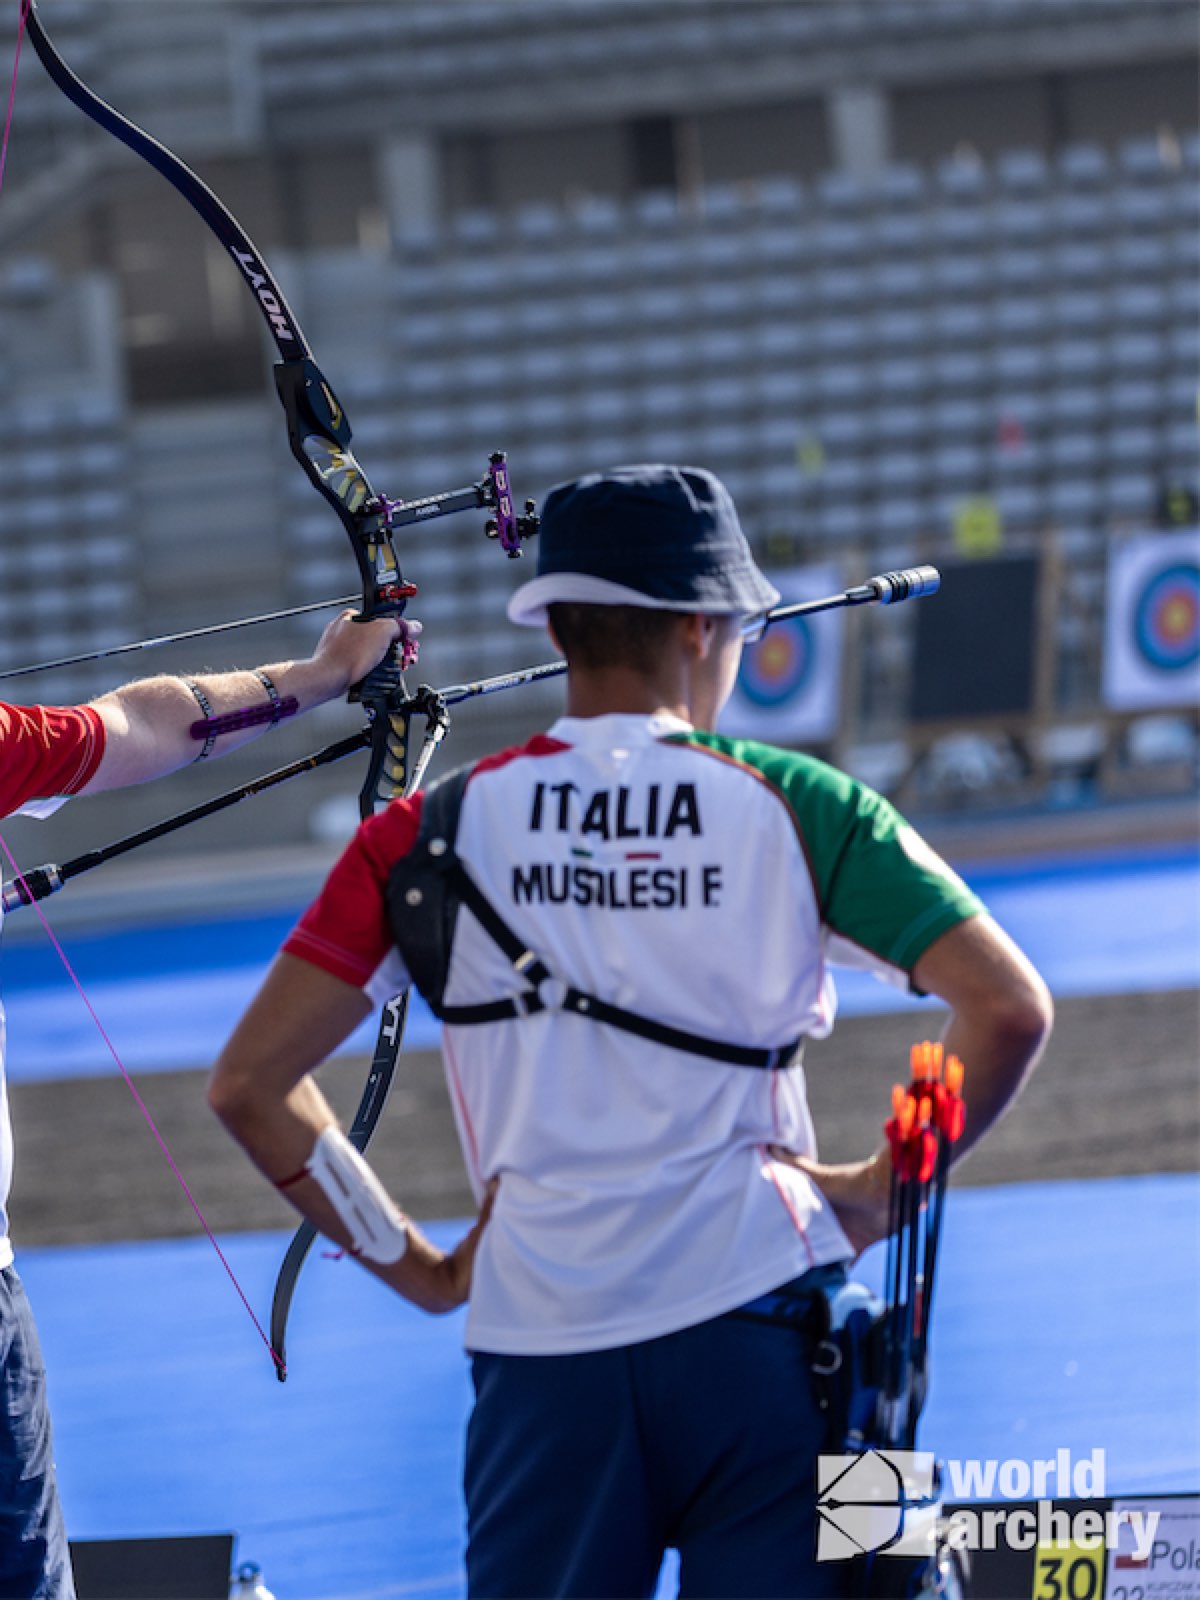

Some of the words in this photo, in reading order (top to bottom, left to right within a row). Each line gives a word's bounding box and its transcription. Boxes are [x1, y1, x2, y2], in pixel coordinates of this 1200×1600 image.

[230, 245, 293, 340] HOYT
[529, 780, 703, 842] ITALIA
[383, 995, 402, 1047] YT
[1037, 1557, 1097, 1600] 30
